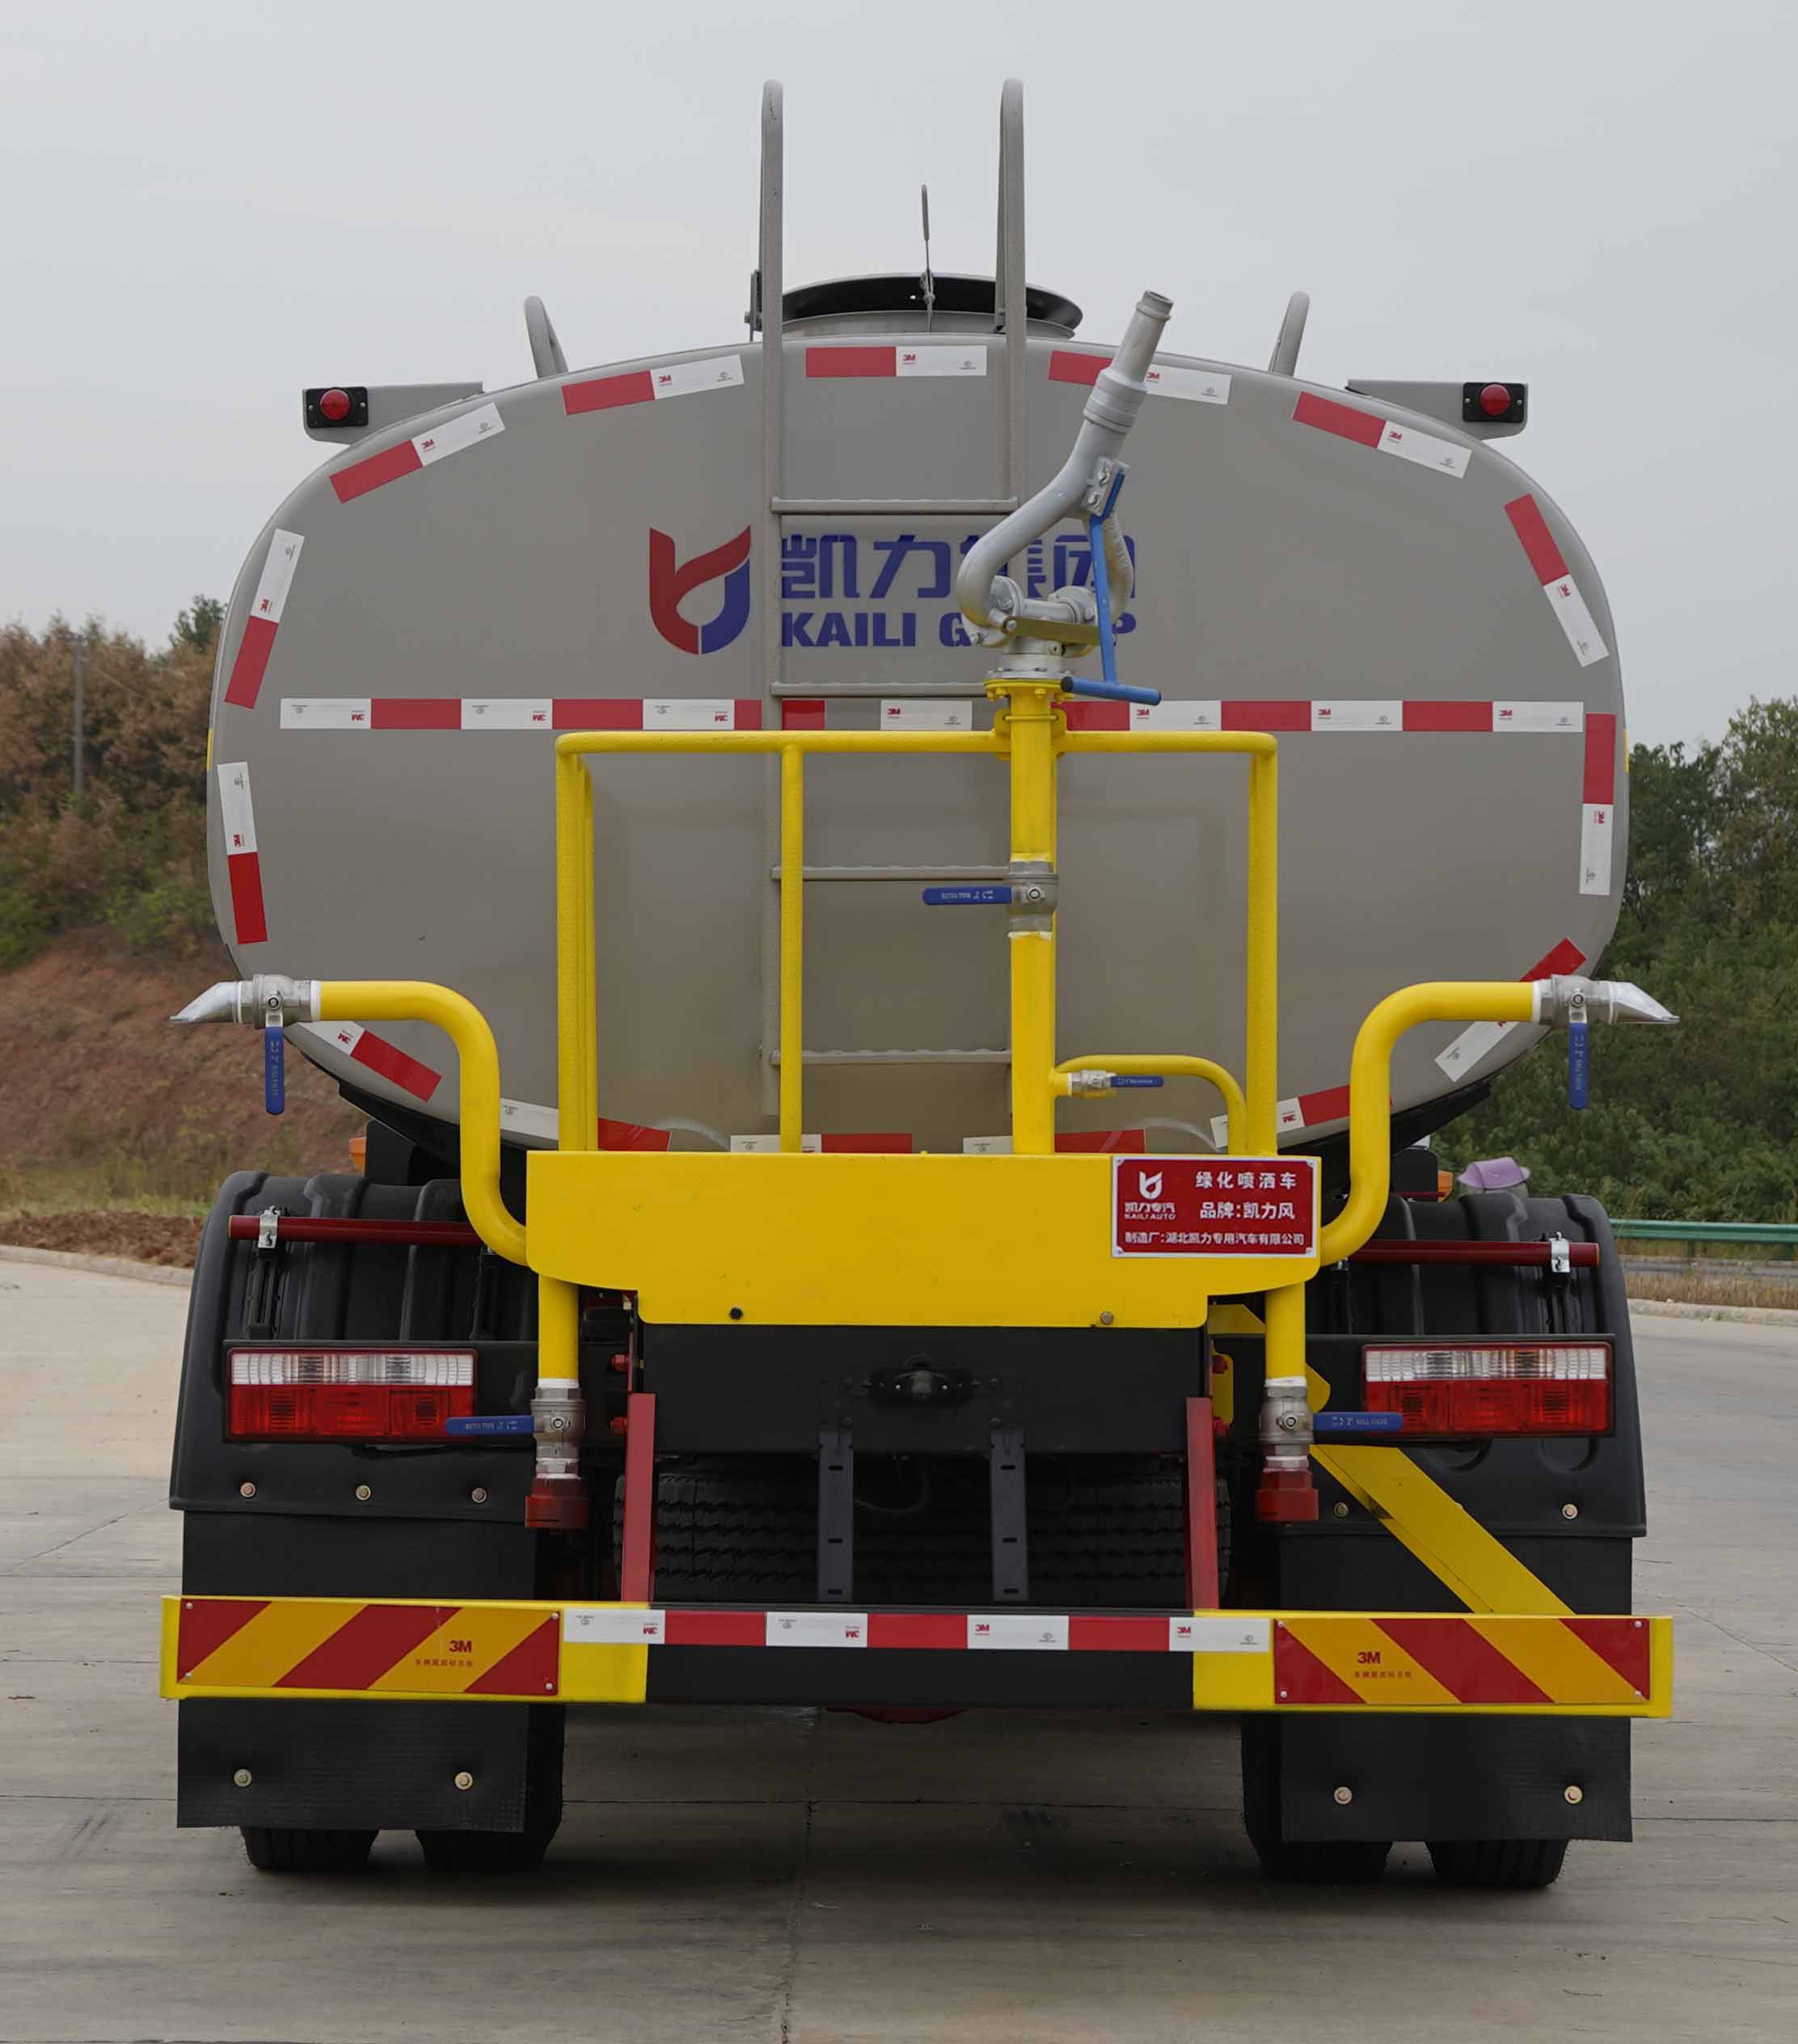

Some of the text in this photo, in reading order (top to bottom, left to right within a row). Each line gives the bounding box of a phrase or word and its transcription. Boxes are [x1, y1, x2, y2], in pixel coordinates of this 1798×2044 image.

[782, 612, 916, 647] KAILI
[1196, 1172, 1297, 1189] 绿化喷洒车
[1200, 1201, 1295, 1219] 品牌:凯力风
[450, 1641, 472, 1653] 3M
[1357, 1651, 1381, 1664] 3M
